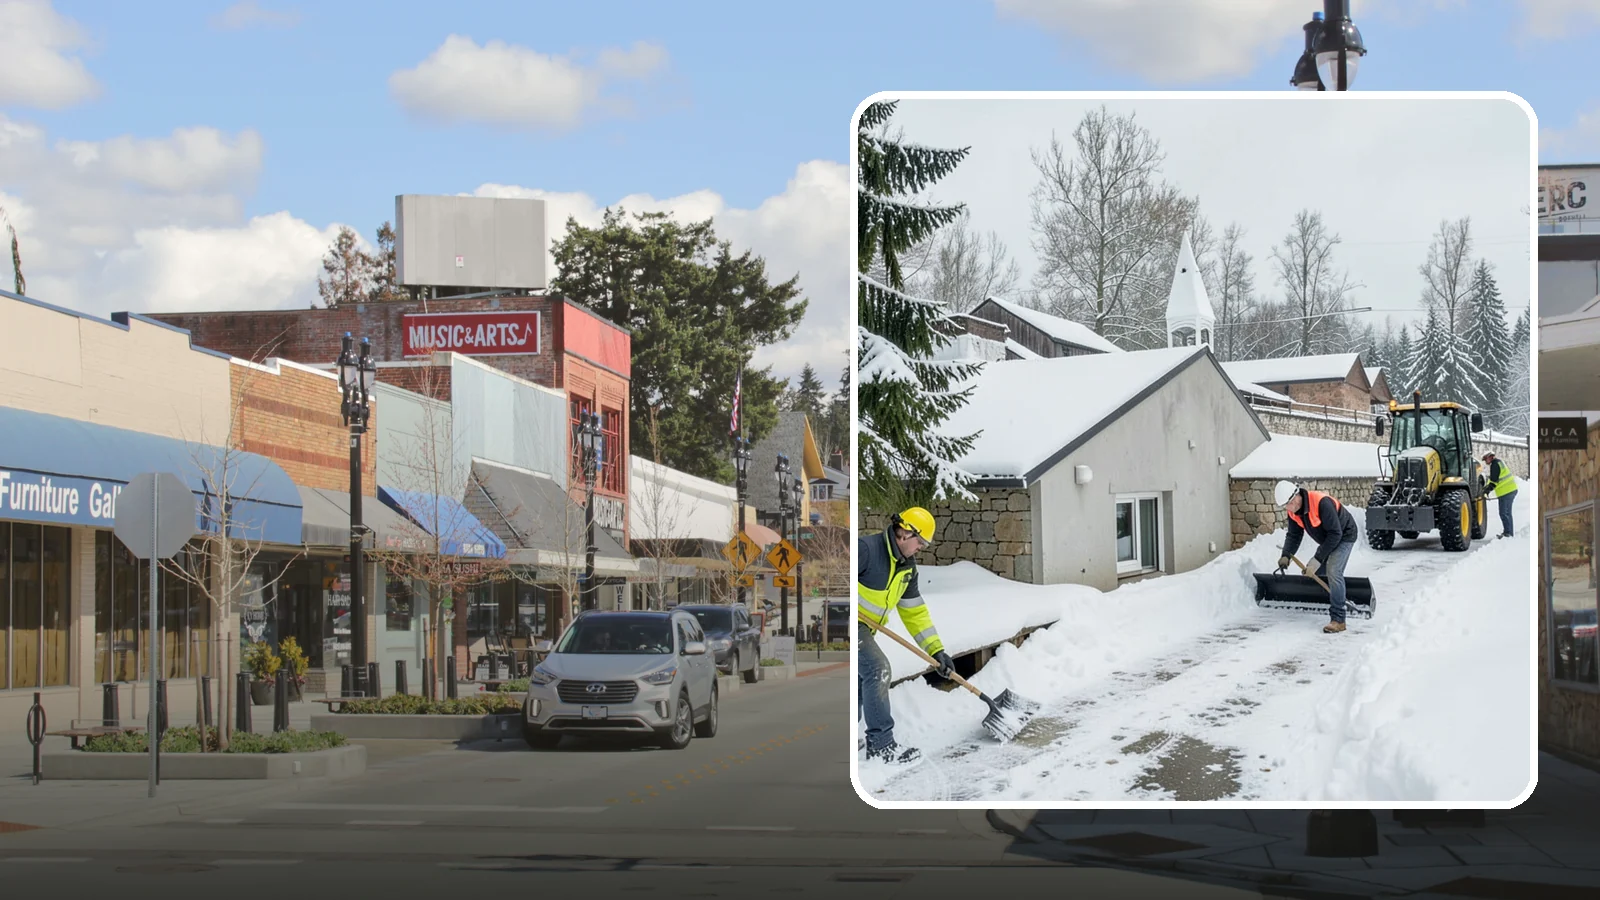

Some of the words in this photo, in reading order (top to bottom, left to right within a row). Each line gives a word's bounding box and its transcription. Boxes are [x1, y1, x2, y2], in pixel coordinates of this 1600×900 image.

[1540, 427, 1578, 437] UGA
[0, 471, 79, 515] Furniture
[89, 482, 122, 519] Gal
